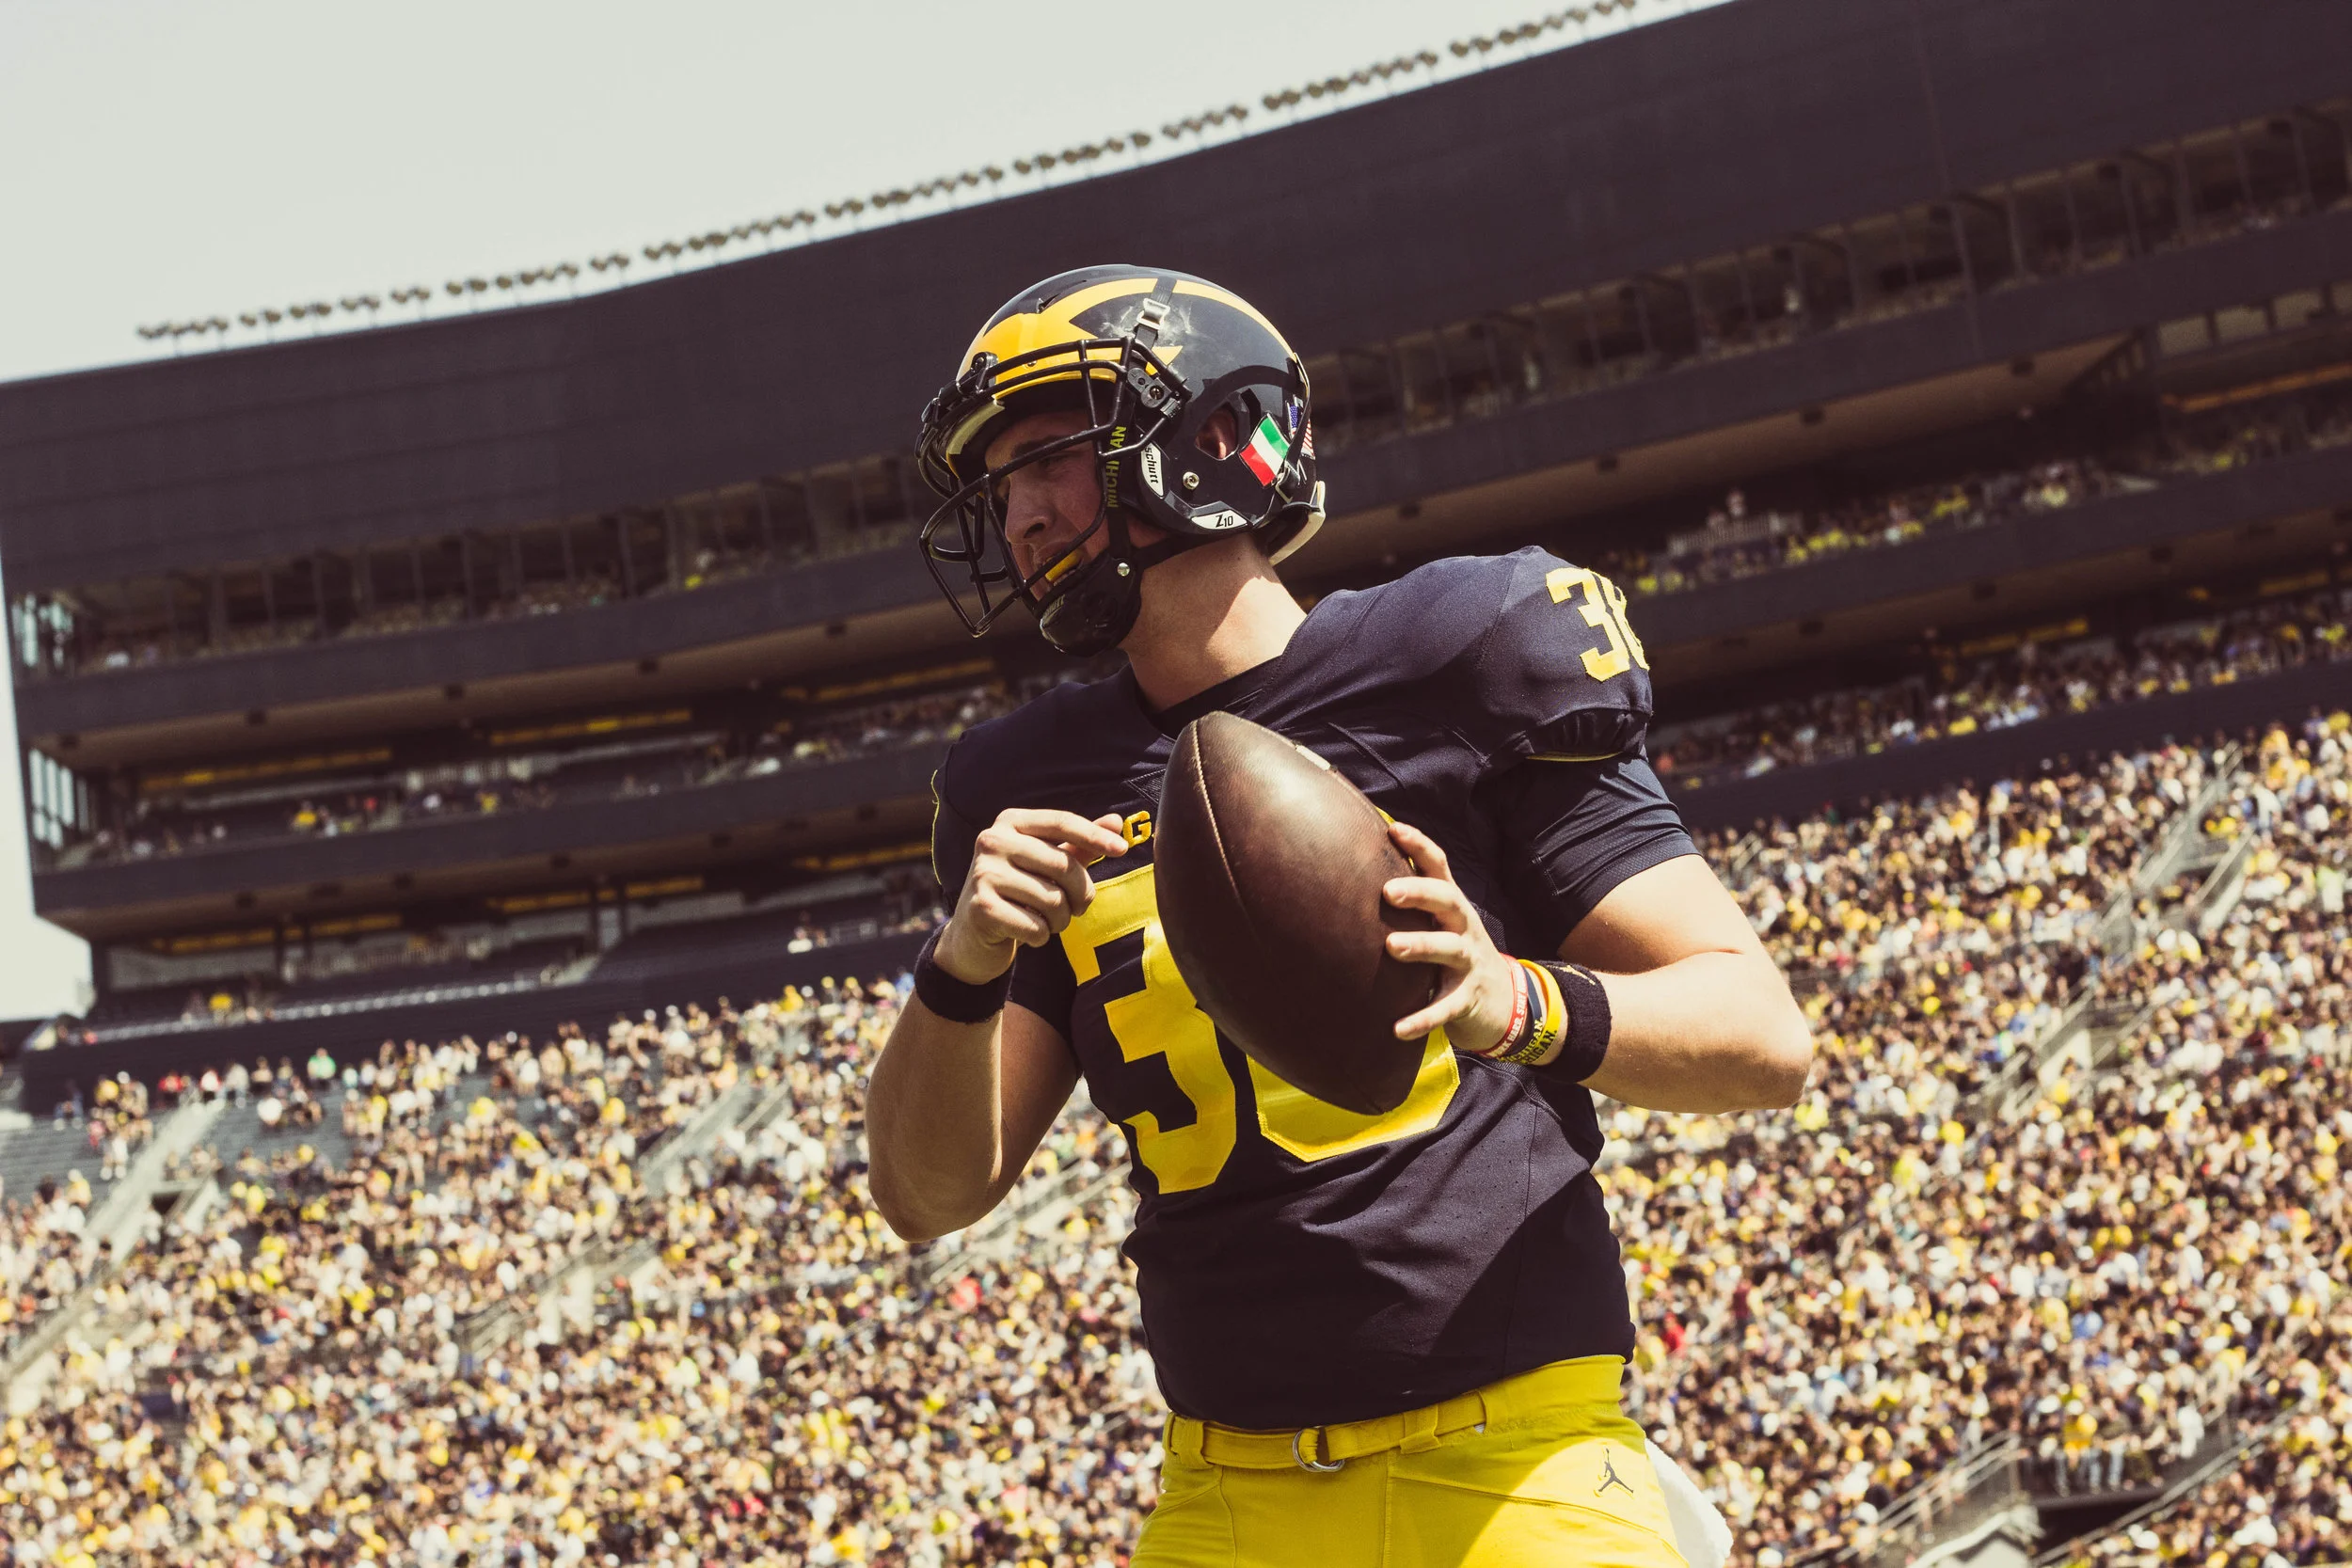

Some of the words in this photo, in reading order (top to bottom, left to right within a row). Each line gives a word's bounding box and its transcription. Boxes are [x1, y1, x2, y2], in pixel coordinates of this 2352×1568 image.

[1105, 426, 1127, 508] MICHIAN
[1144, 447, 1159, 484] schutt
[1215, 514, 1233, 528] Z10
